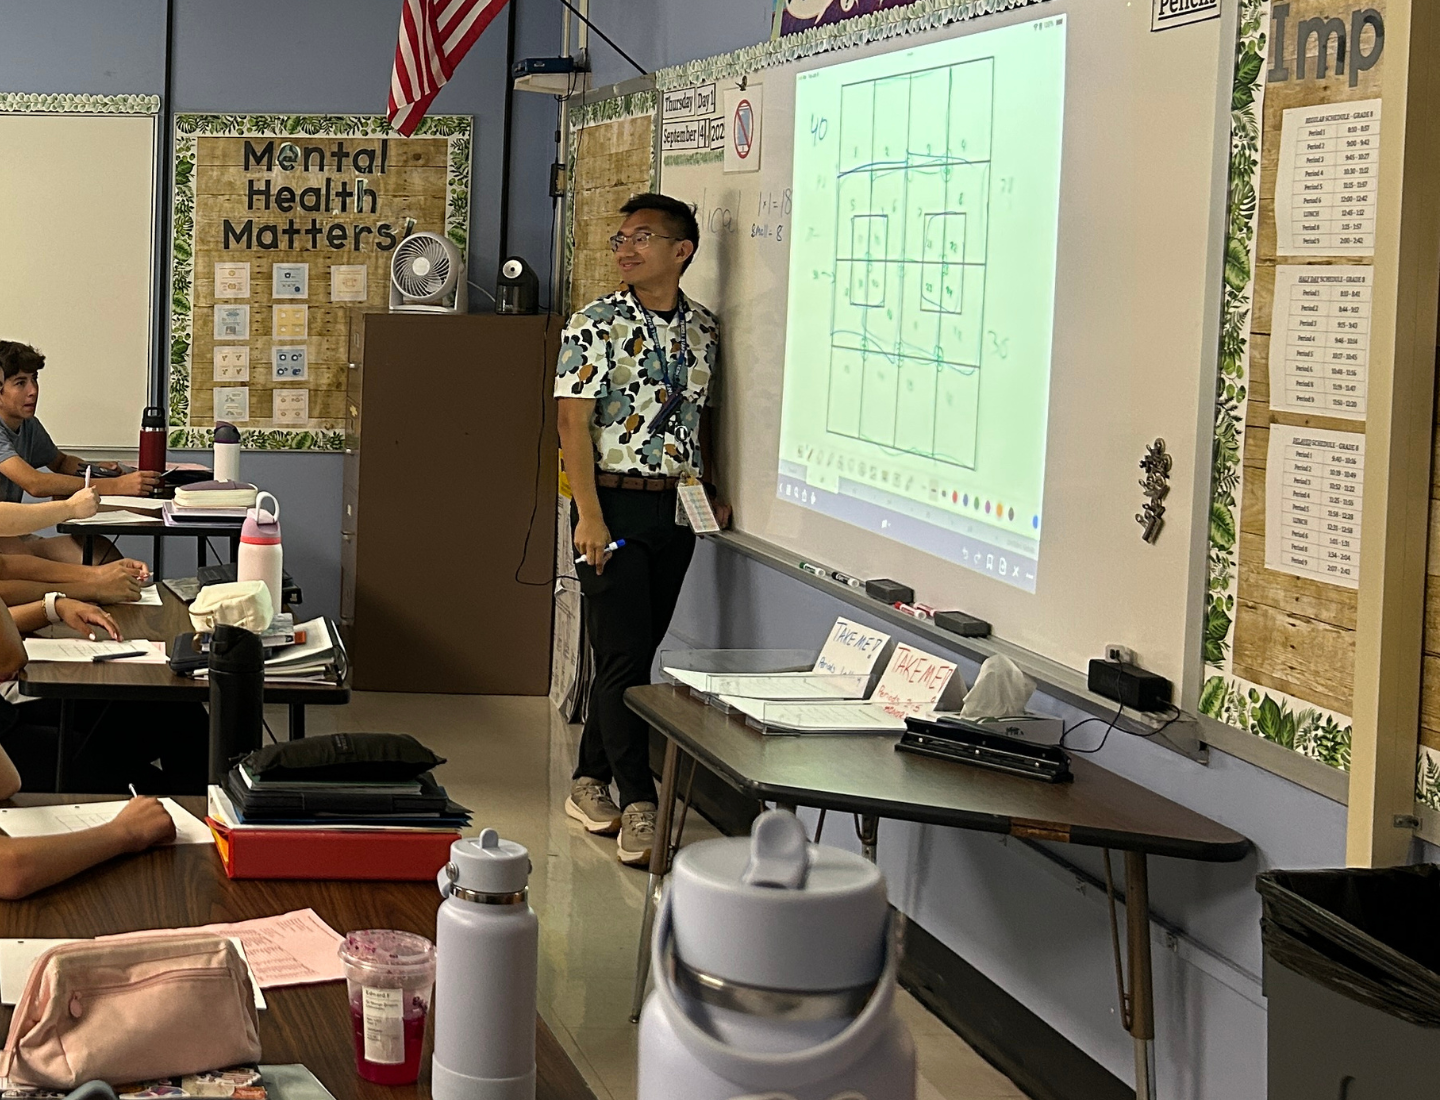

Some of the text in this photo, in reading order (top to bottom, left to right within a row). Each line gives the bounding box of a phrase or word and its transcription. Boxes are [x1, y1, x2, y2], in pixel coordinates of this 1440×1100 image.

[1268, 3, 1384, 88] Imp
[665, 92, 693, 113] Thursday
[698, 93, 710, 112] Day
[663, 125, 697, 148] September
[712, 123, 725, 142] 202
[811, 114, 828, 146] 40
[244, 139, 388, 175] Mental
[247, 178, 378, 214] Health
[833, 622, 856, 646] TAKE
[892, 646, 928, 683] TAKE
